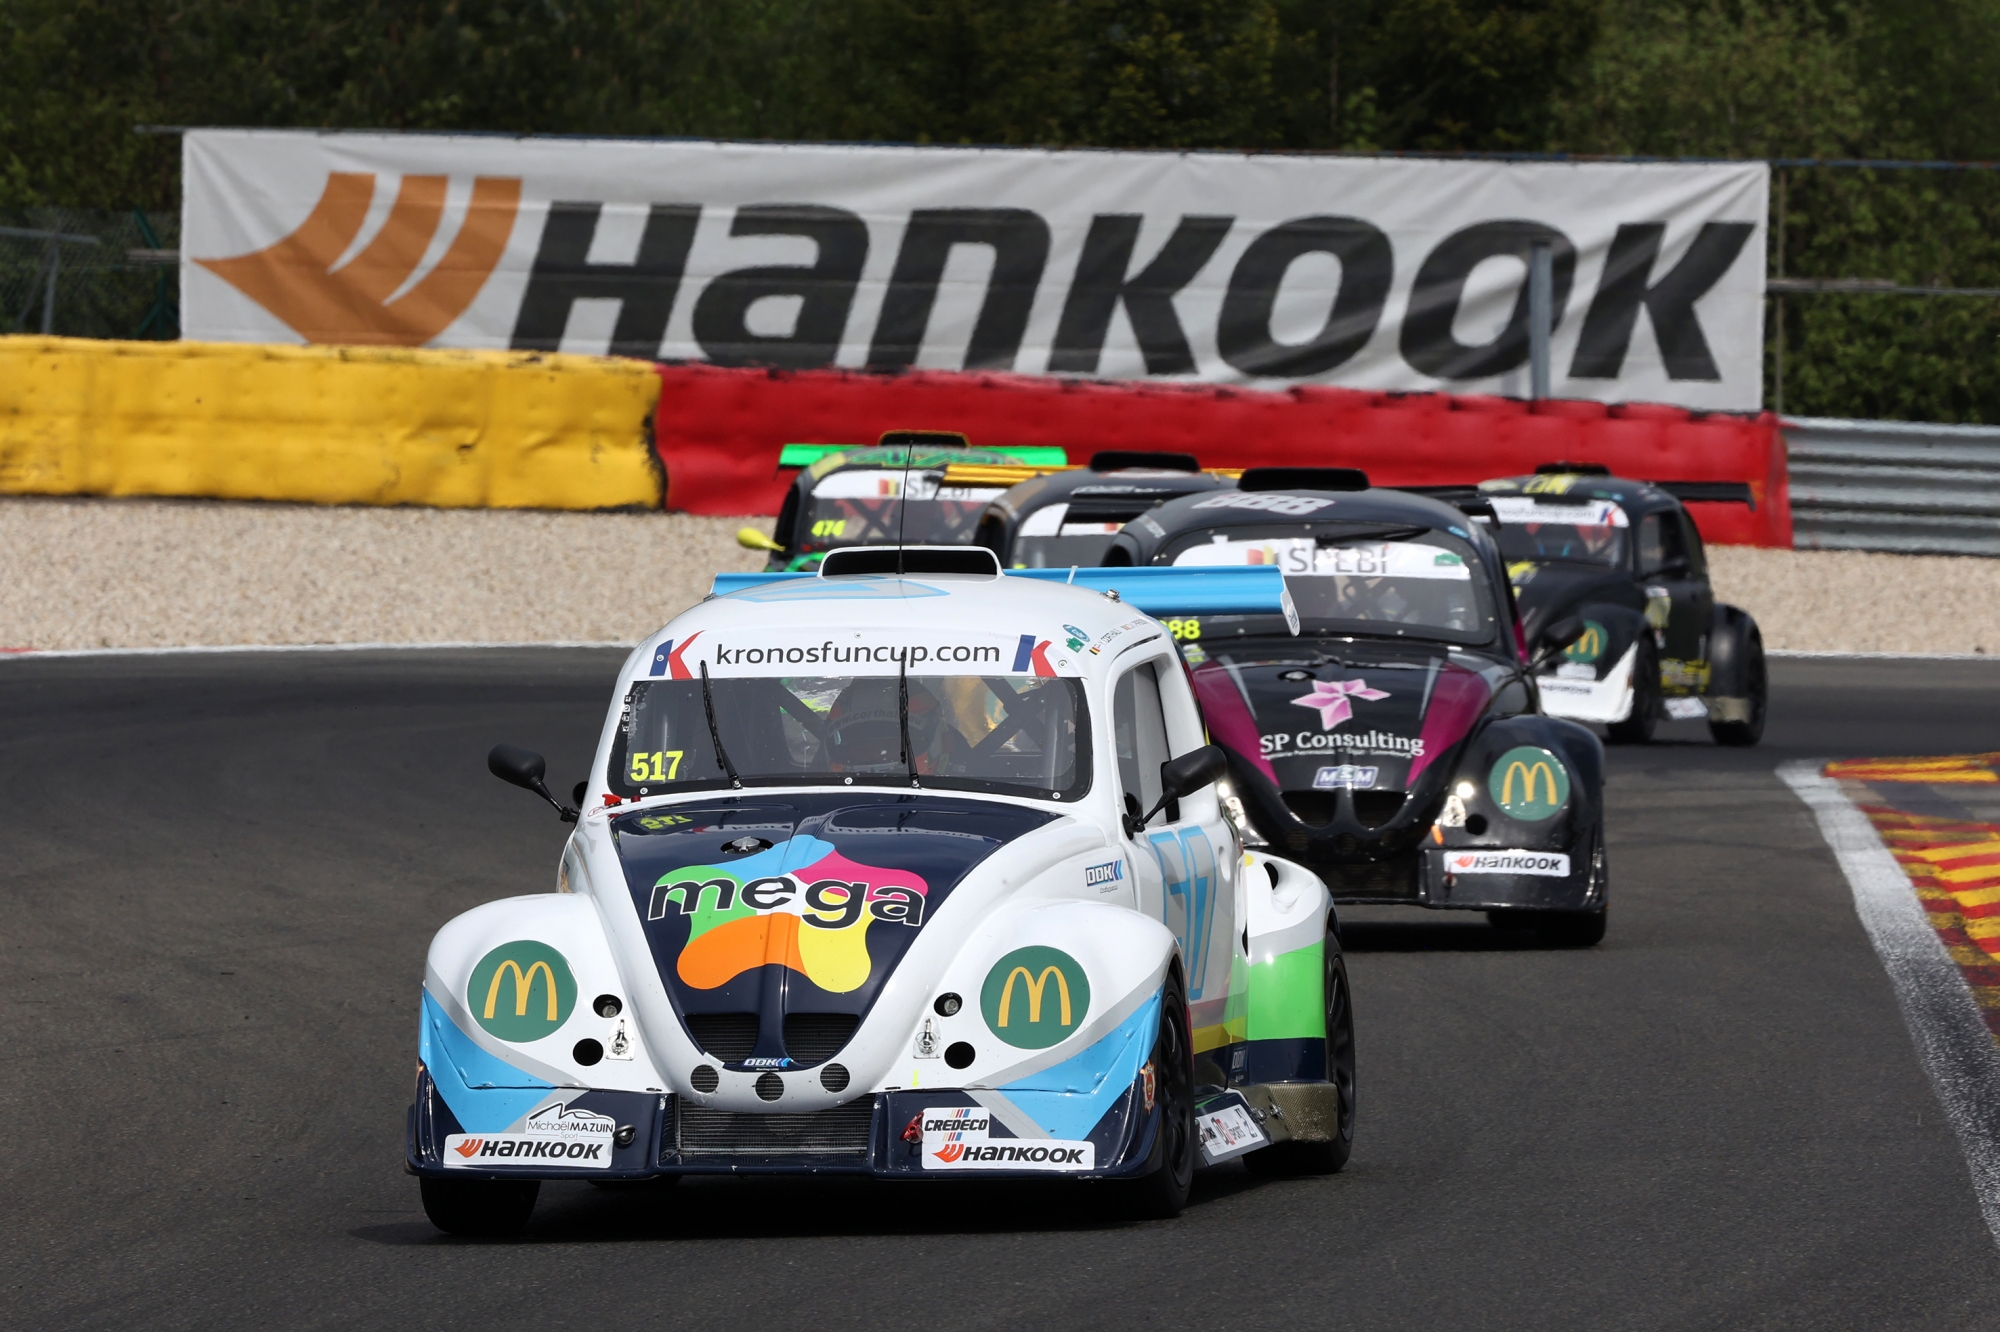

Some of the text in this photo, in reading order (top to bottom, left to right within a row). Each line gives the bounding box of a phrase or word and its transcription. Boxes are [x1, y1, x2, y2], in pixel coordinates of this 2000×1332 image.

[811, 519, 846, 538] 474
[1160, 619, 1201, 640] 88
[716, 641, 1000, 667] kronosfuncup.com
[1259, 733, 1290, 753] SP
[1296, 730, 1426, 757] Consulting
[630, 750, 684, 781] 517
[1086, 864, 1113, 884] DDK
[648, 876, 926, 930] mega
[560, 1131, 579, 1140] Sport
[924, 1118, 989, 1132] CREDECO
